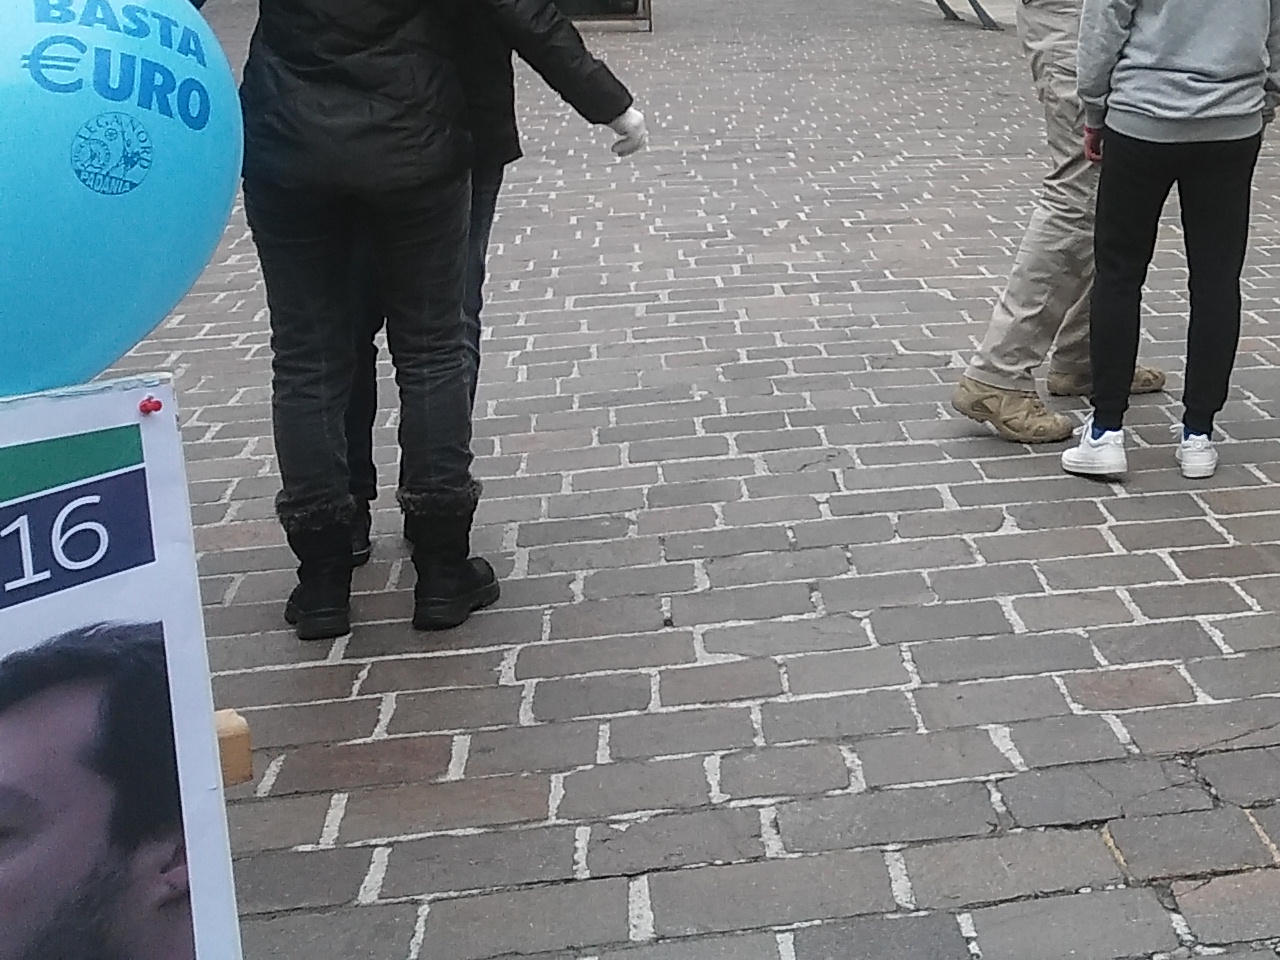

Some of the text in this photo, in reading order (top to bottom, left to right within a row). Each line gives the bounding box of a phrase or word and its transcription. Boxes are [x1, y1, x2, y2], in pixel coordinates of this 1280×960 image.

[20, 35, 211, 131] €URO
[78, 115, 153, 169] LEGA NORD
[79, 171, 131, 194] PADANIA
[0, 495, 109, 591] 16
